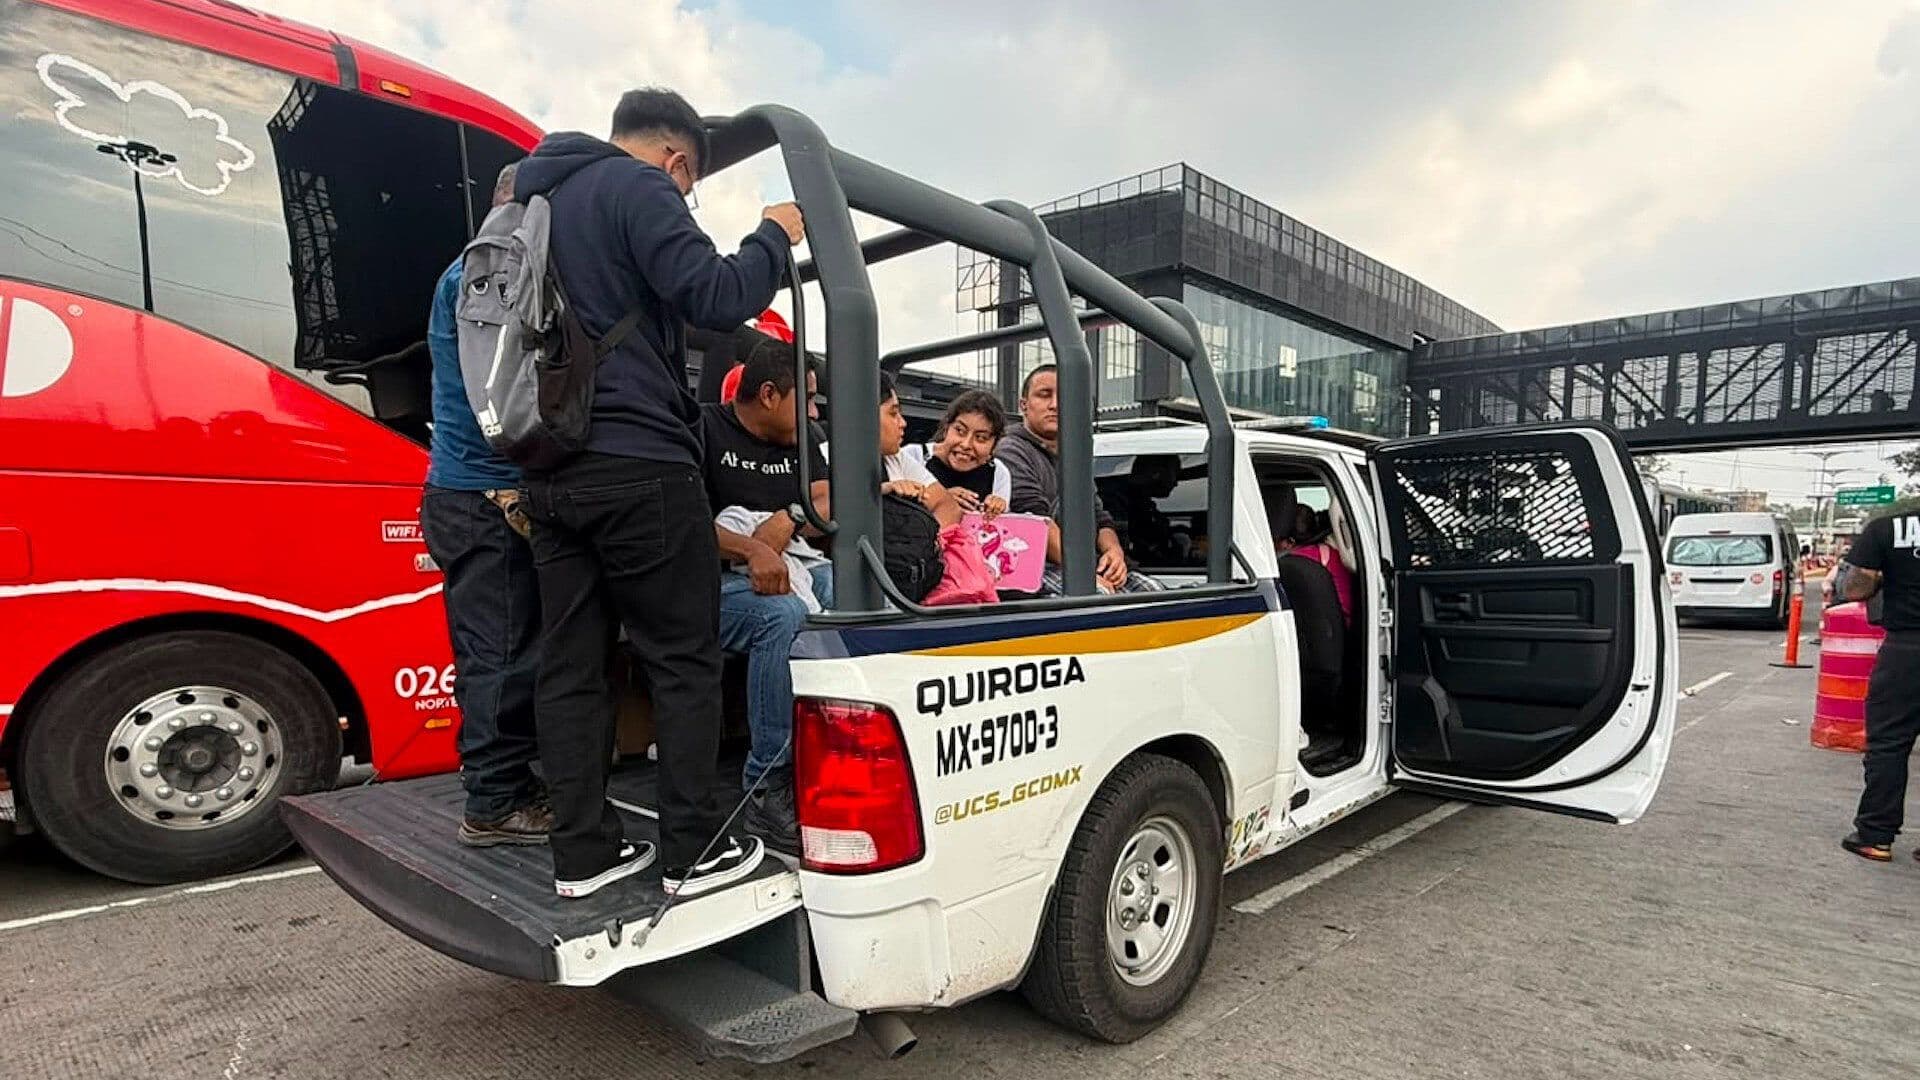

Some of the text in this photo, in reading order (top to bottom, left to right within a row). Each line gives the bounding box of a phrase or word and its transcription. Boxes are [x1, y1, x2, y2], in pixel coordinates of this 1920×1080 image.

[386, 525, 417, 537] WIFI
[916, 656, 1085, 717] QUIROGA
[935, 765, 1082, 825] @UCS_GCDMX
